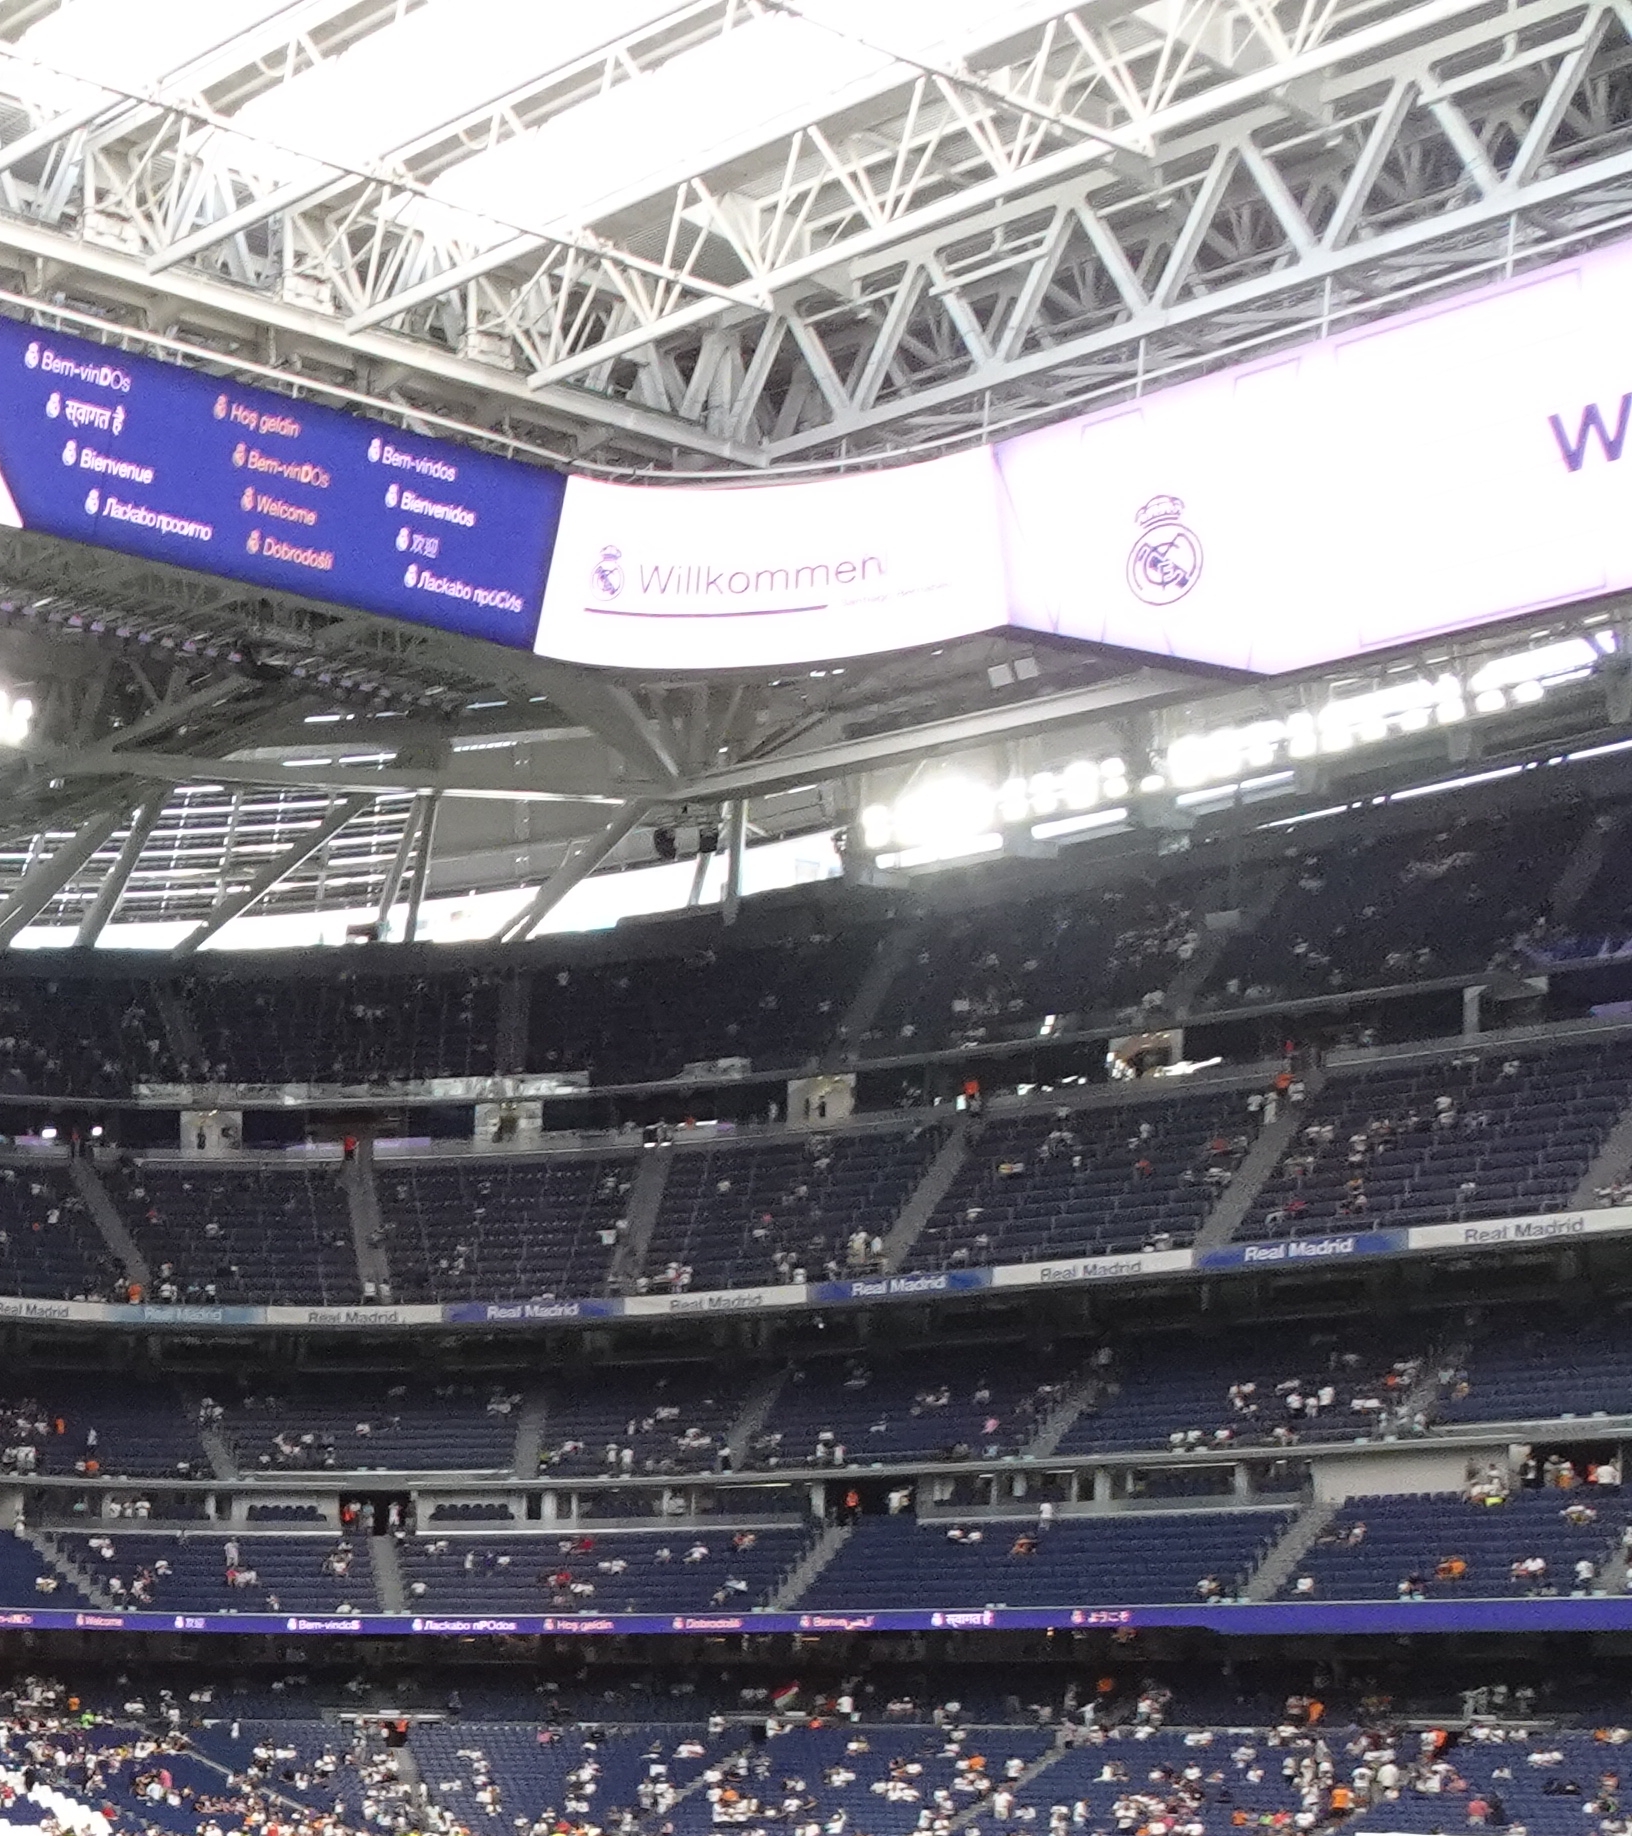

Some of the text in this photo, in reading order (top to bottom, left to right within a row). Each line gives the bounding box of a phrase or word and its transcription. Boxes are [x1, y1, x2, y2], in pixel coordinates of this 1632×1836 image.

[80, 448, 155, 485] Bienvenue
[256, 494, 317, 526] Welcome
[400, 490, 477, 528] Bienvenidos
[639, 553, 886, 596] Willkommen
[1465, 1217, 1584, 1244] Real Madrid
[1245, 1238, 1355, 1262] Real Madrid
[852, 1276, 946, 1297] Real Madrid
[487, 1303, 580, 1320] Real Madrid
